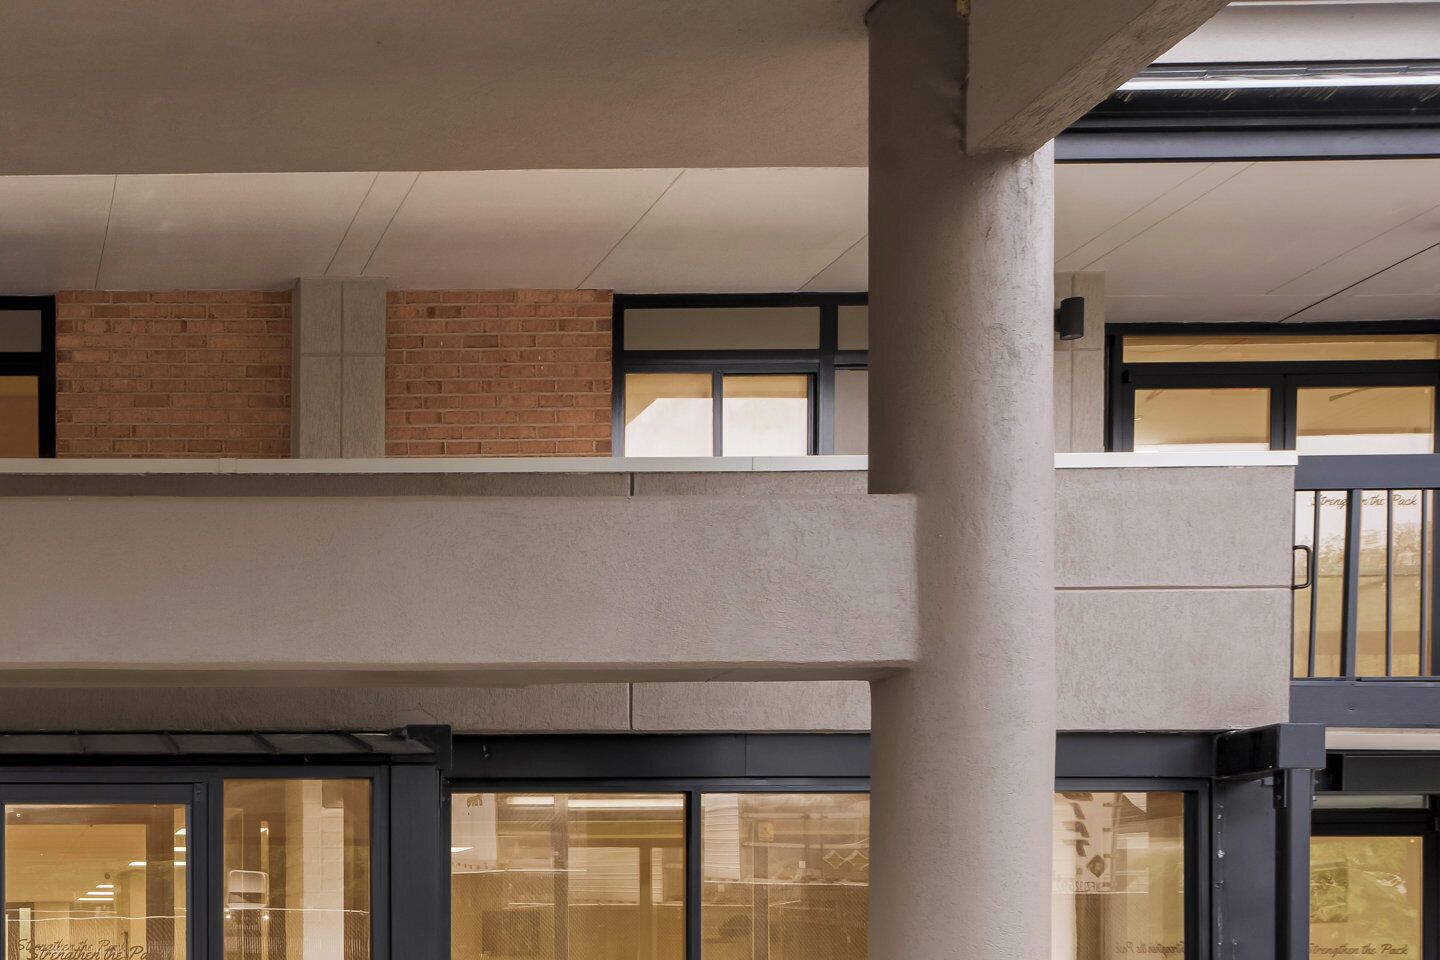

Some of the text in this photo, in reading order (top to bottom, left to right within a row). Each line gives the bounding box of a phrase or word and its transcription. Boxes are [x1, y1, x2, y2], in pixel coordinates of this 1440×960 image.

[103, 946, 124, 960] the
[129, 945, 150, 960] Pa
[1361, 943, 1377, 955] the
[1381, 943, 1408, 955] Pack
